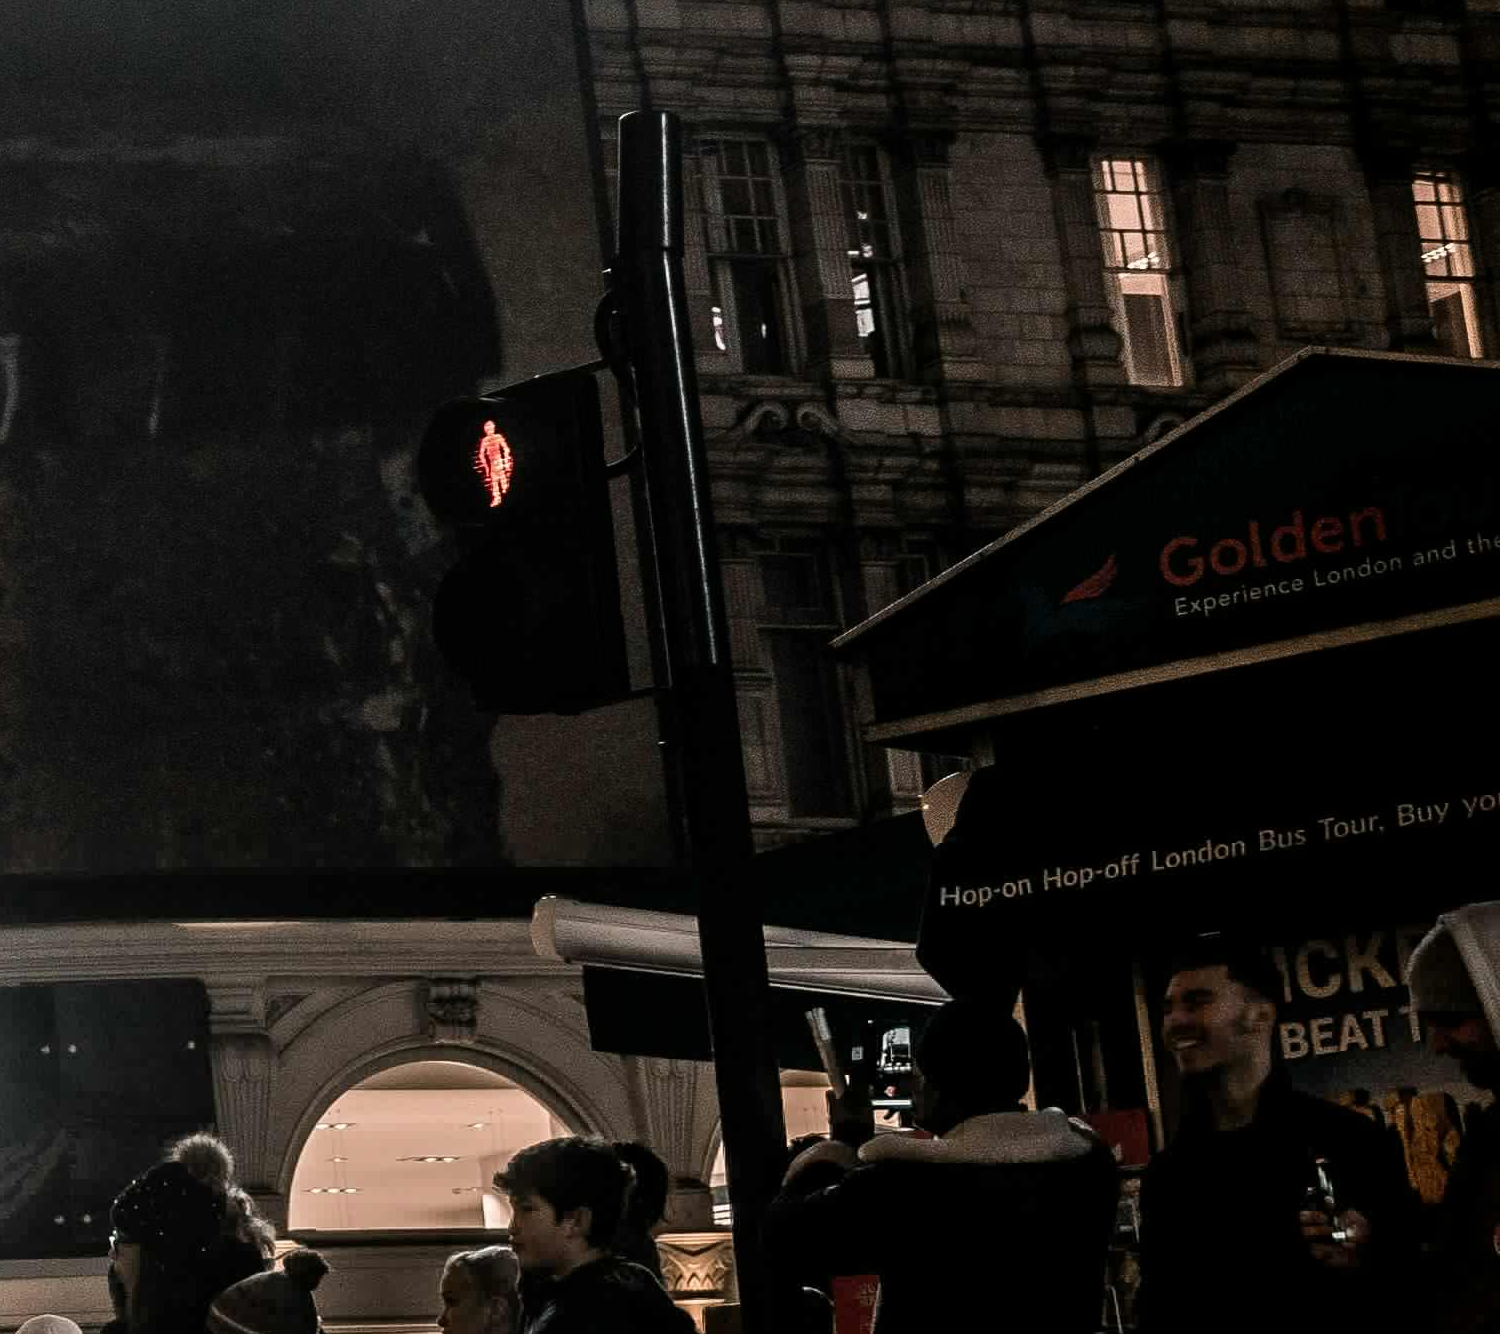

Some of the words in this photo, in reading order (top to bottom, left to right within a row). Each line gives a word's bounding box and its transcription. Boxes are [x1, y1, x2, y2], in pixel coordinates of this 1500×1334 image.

[1159, 505, 1388, 587] Golden
[1173, 577, 1305, 619] Experience
[1313, 555, 1402, 589] London
[1411, 540, 1458, 568] and
[939, 874, 1033, 909] Hop-on
[1042, 853, 1142, 892] Hop-off
[1151, 837, 1247, 873] London
[1259, 827, 1308, 853] Bus
[1316, 813, 1387, 842] Tour,
[1395, 800, 1451, 829] Buy
[1460, 793, 1500, 819] yo
[1278, 1008, 1390, 1060] BEAT
